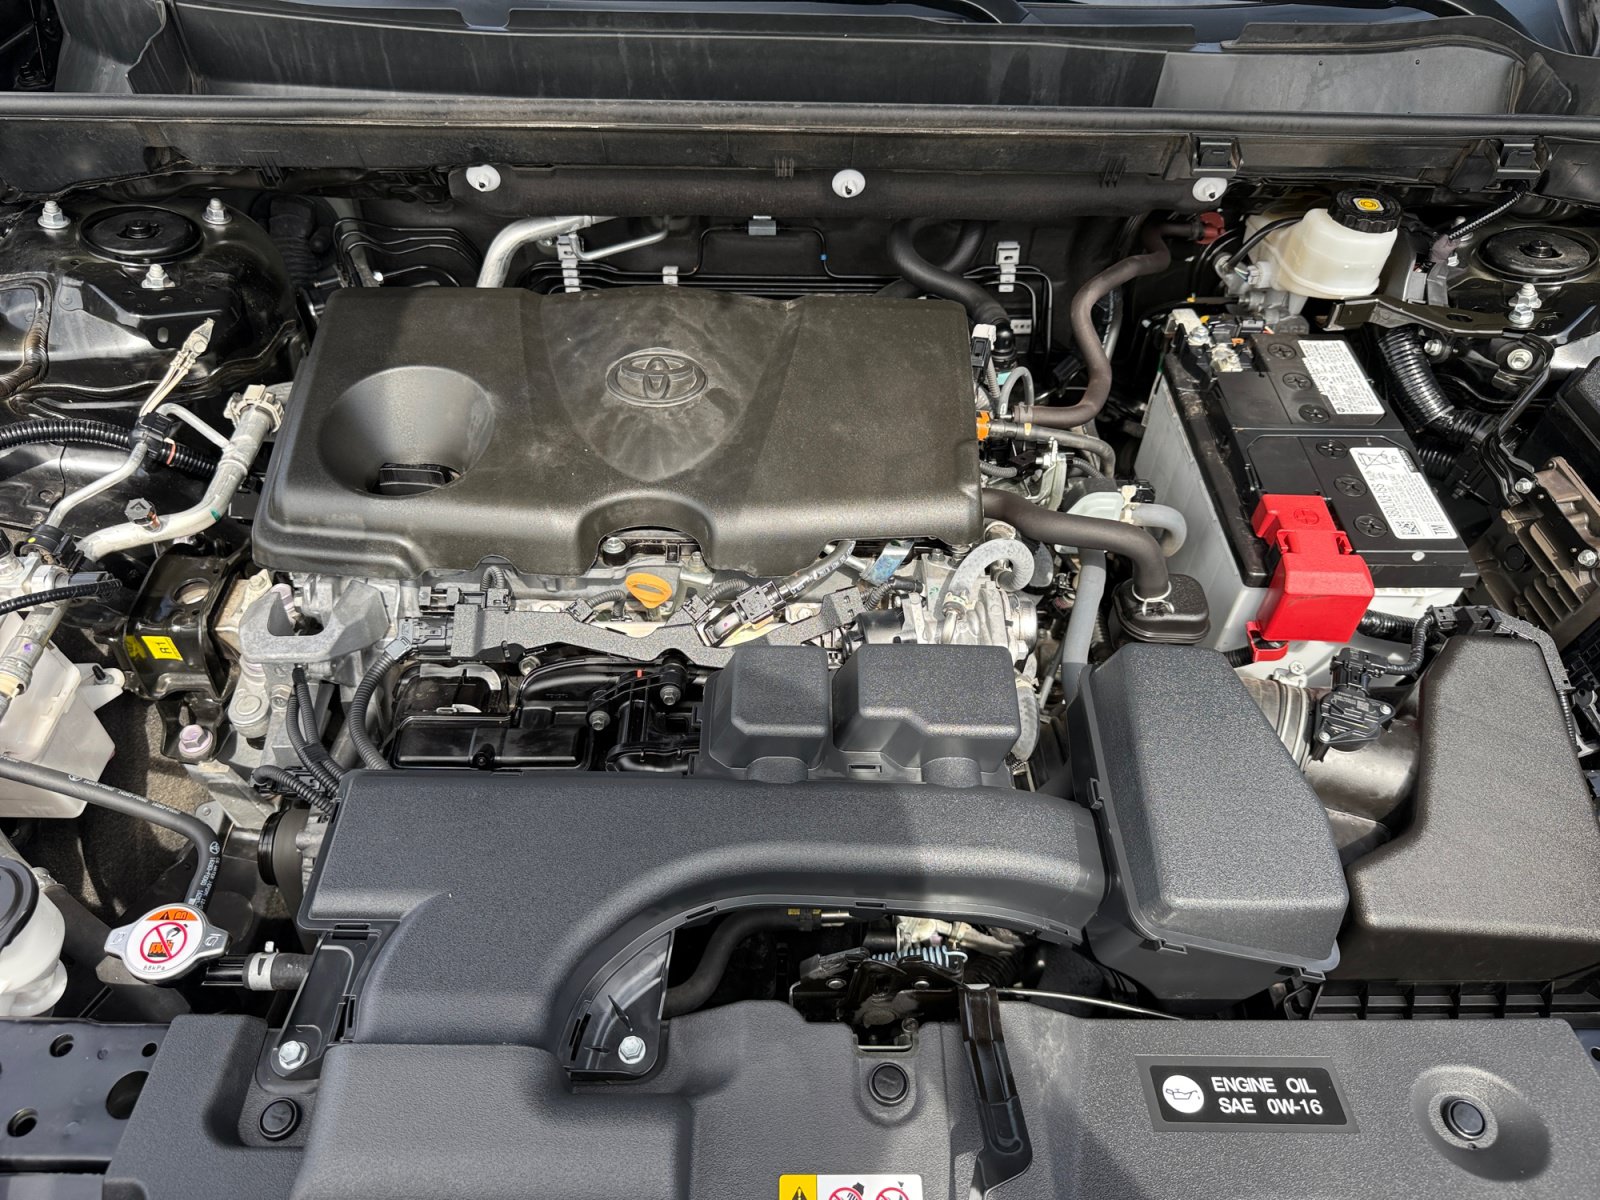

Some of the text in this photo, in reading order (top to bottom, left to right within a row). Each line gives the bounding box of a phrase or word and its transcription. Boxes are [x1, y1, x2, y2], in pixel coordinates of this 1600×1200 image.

[1211, 1076, 1317, 1094] ENGINE OIL
[1218, 1097, 1323, 1115] SAE 0W-16
